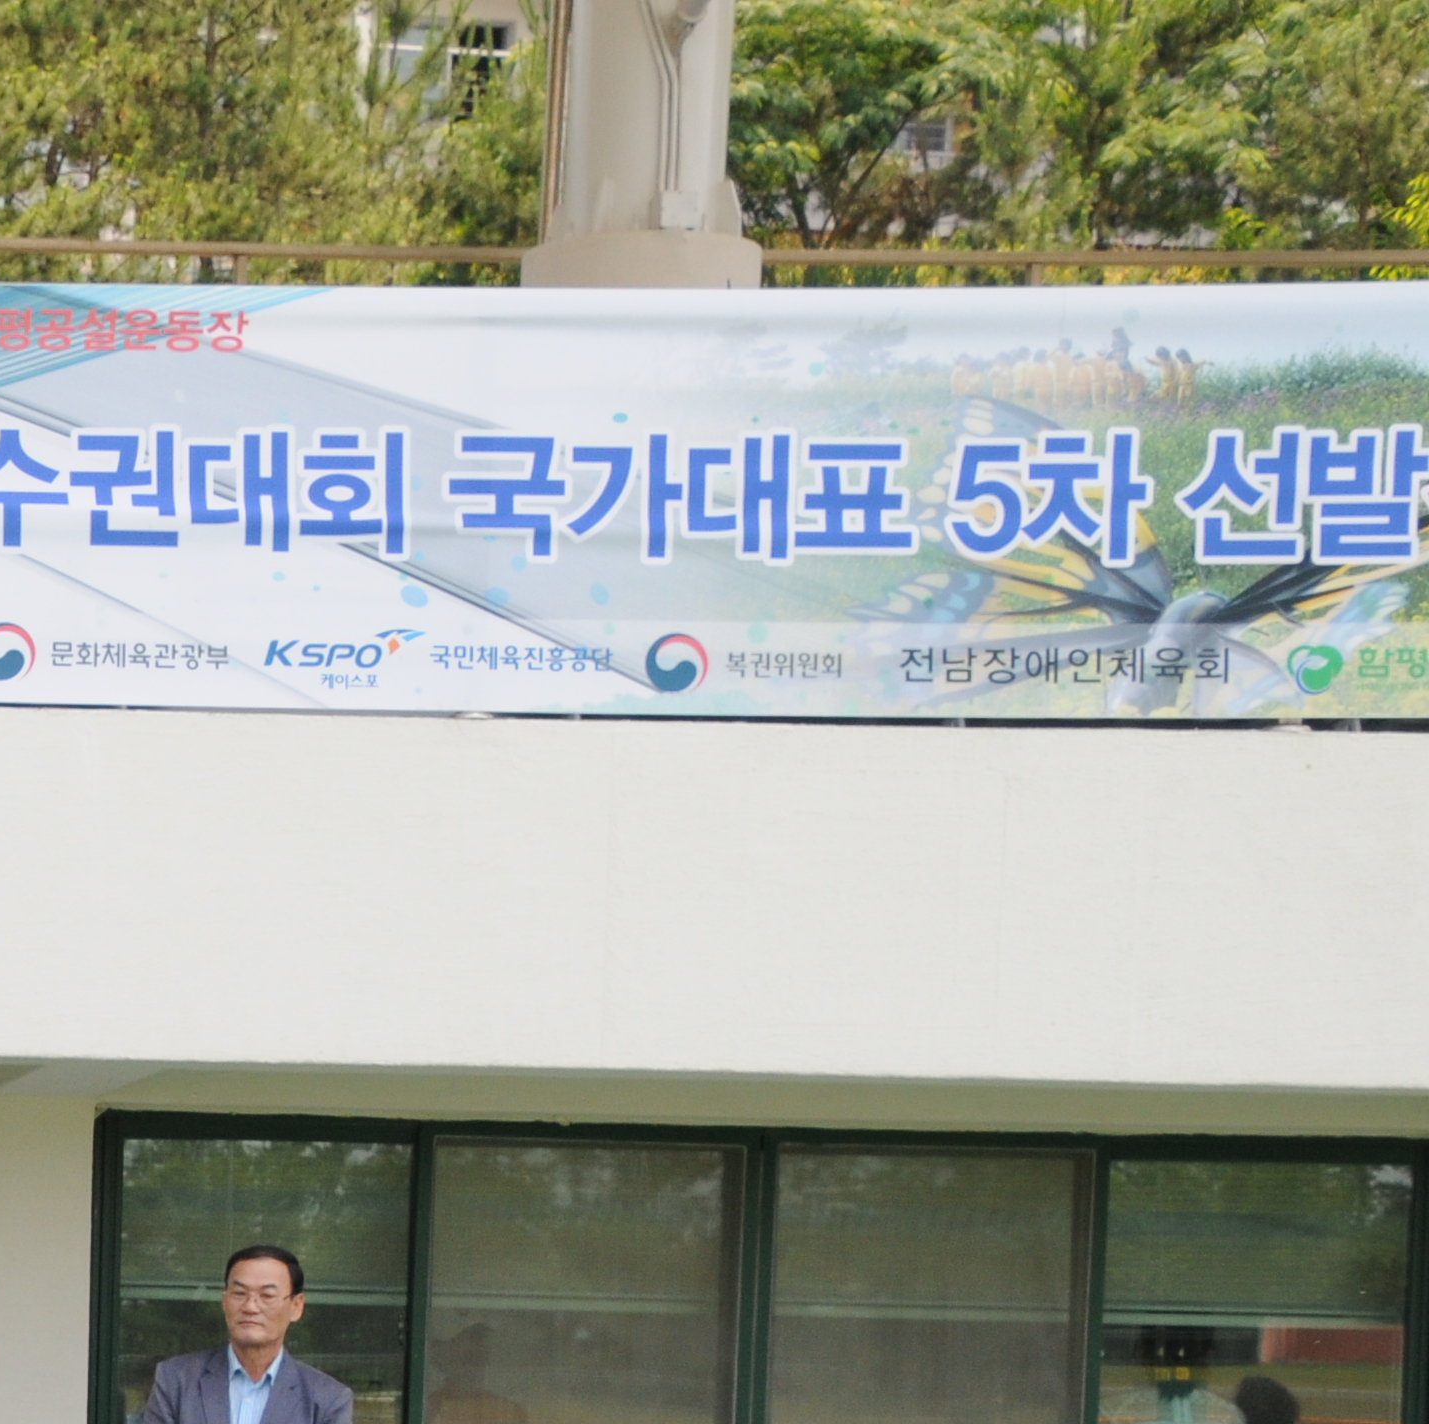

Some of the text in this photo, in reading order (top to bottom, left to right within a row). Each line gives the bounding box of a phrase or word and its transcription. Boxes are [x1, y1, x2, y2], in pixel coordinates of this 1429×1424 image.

[448, 433, 913, 560] 국가대표
[950, 432, 1148, 561] 5차
[1182, 430, 1429, 557] 선발
[50, 641, 231, 671] 문화체육관광부
[262, 639, 384, 669] KSPO
[429, 642, 615, 674] 국민체육진흥공단
[725, 651, 842, 679] 복권위원회
[899, 646, 1230, 685] 전남장애인체육회
[320, 673, 379, 690] 케이스포
